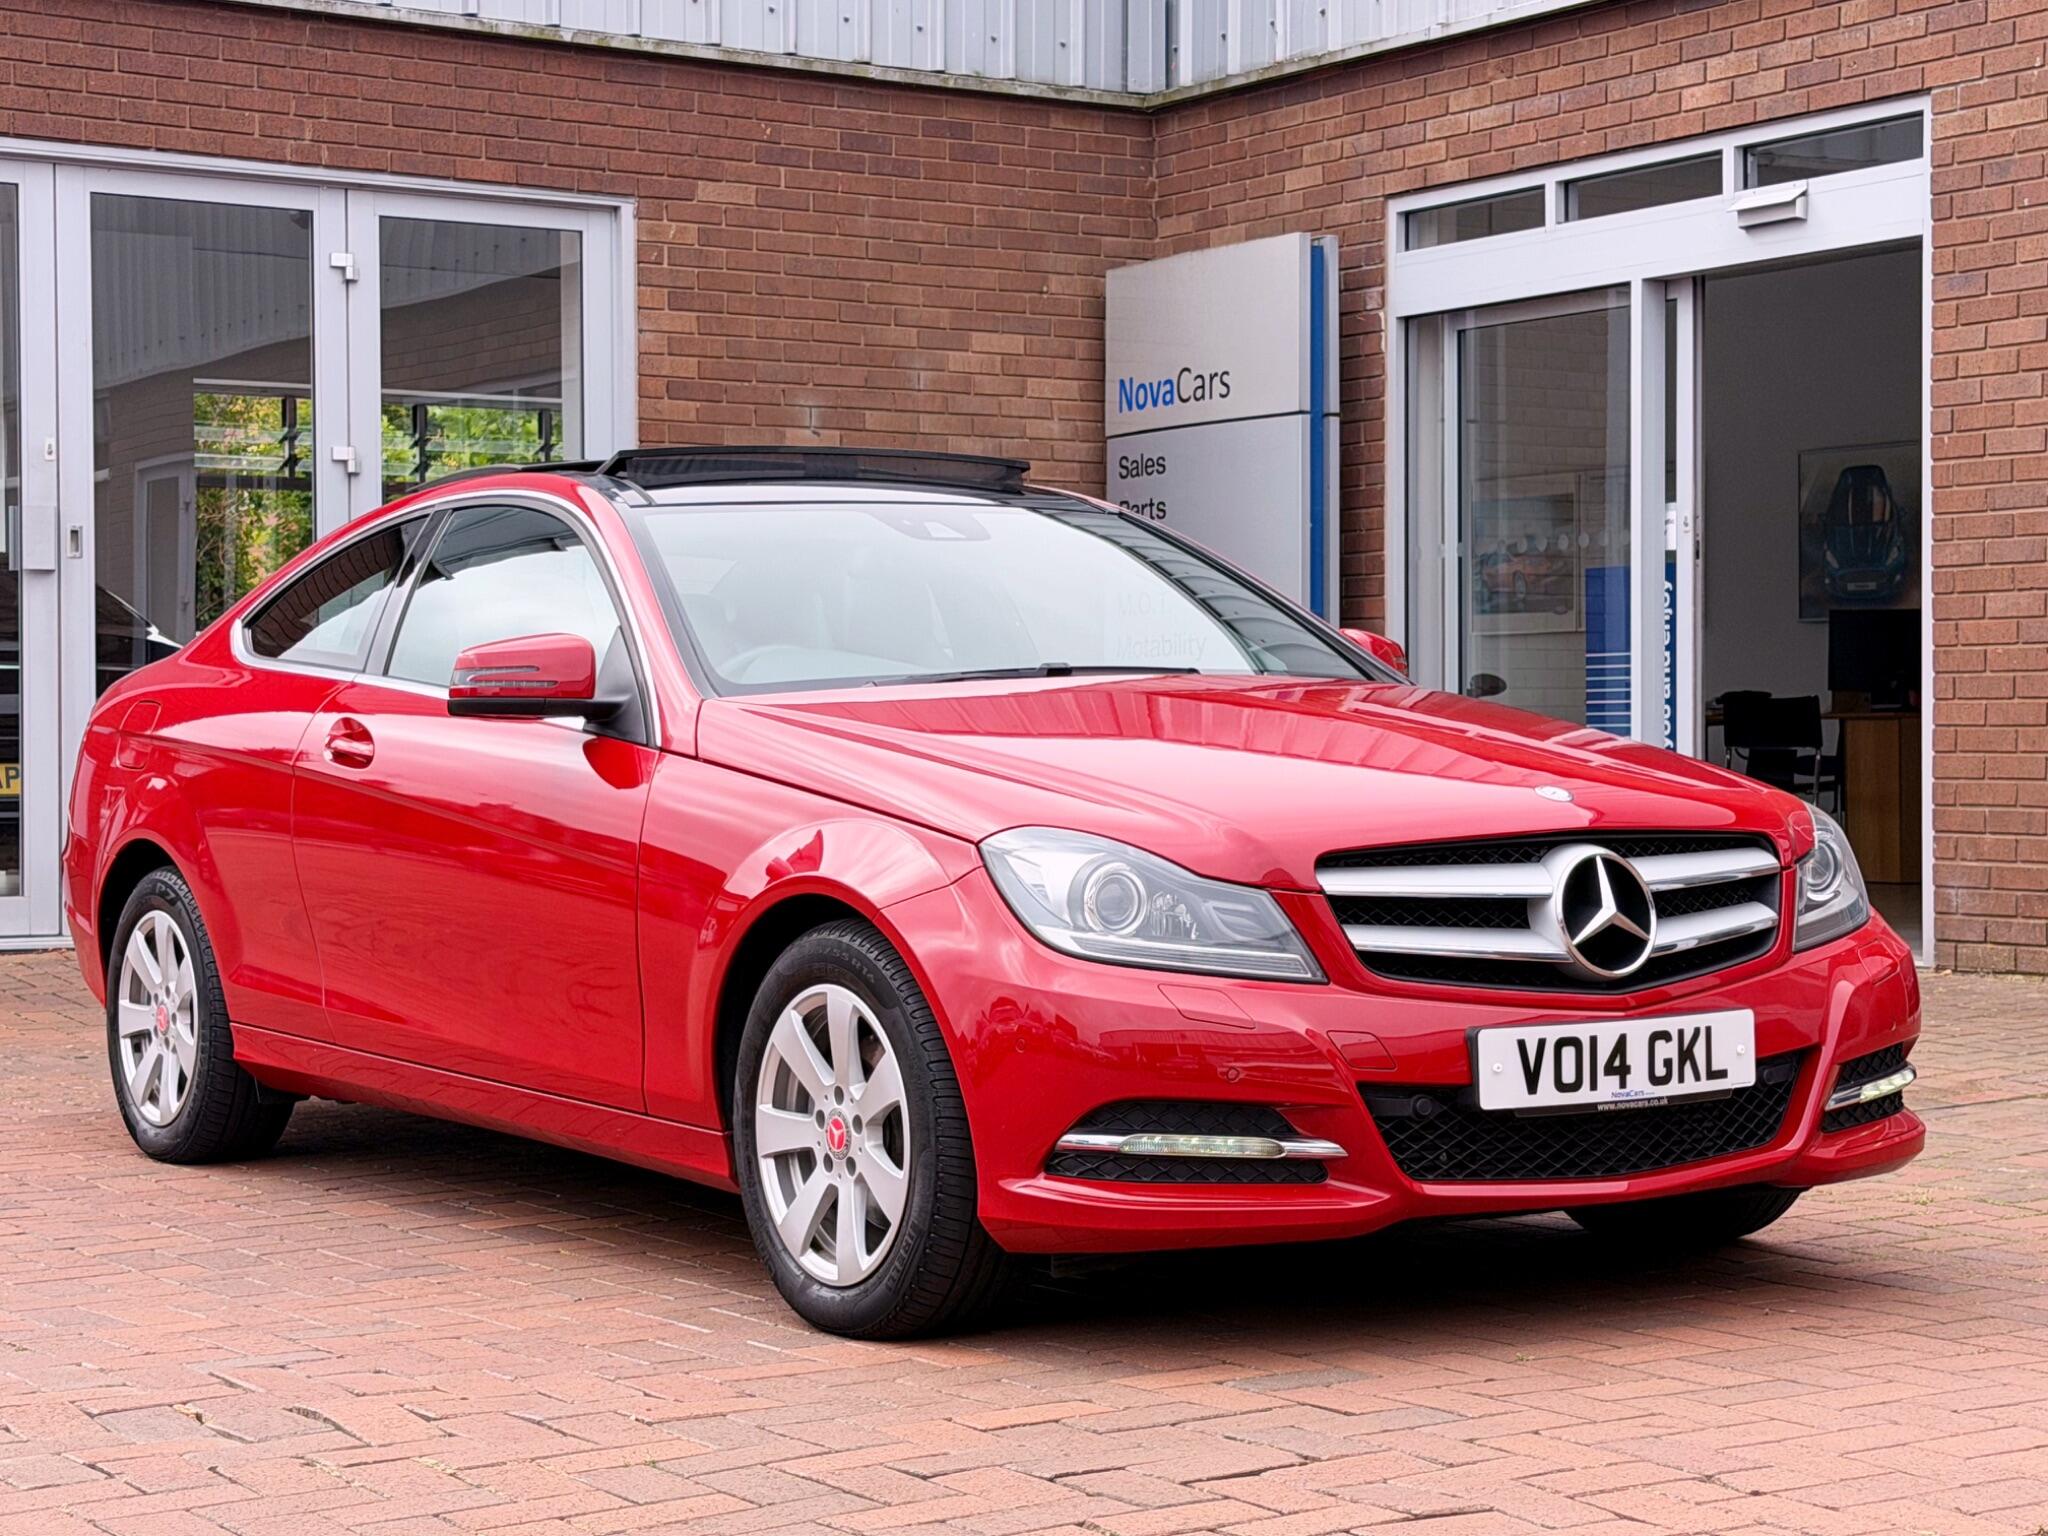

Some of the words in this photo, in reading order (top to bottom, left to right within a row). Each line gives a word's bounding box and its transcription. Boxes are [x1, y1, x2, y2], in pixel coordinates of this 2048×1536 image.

[1118, 366, 1230, 414] NovaCars
[1119, 453, 1166, 480] Sales
[0, 766, 20, 789] P
[1516, 1032, 1632, 1096] VO14
[1648, 1024, 1729, 1088] GKL
[1597, 1096, 1669, 1112] www.novacars.co.uk
